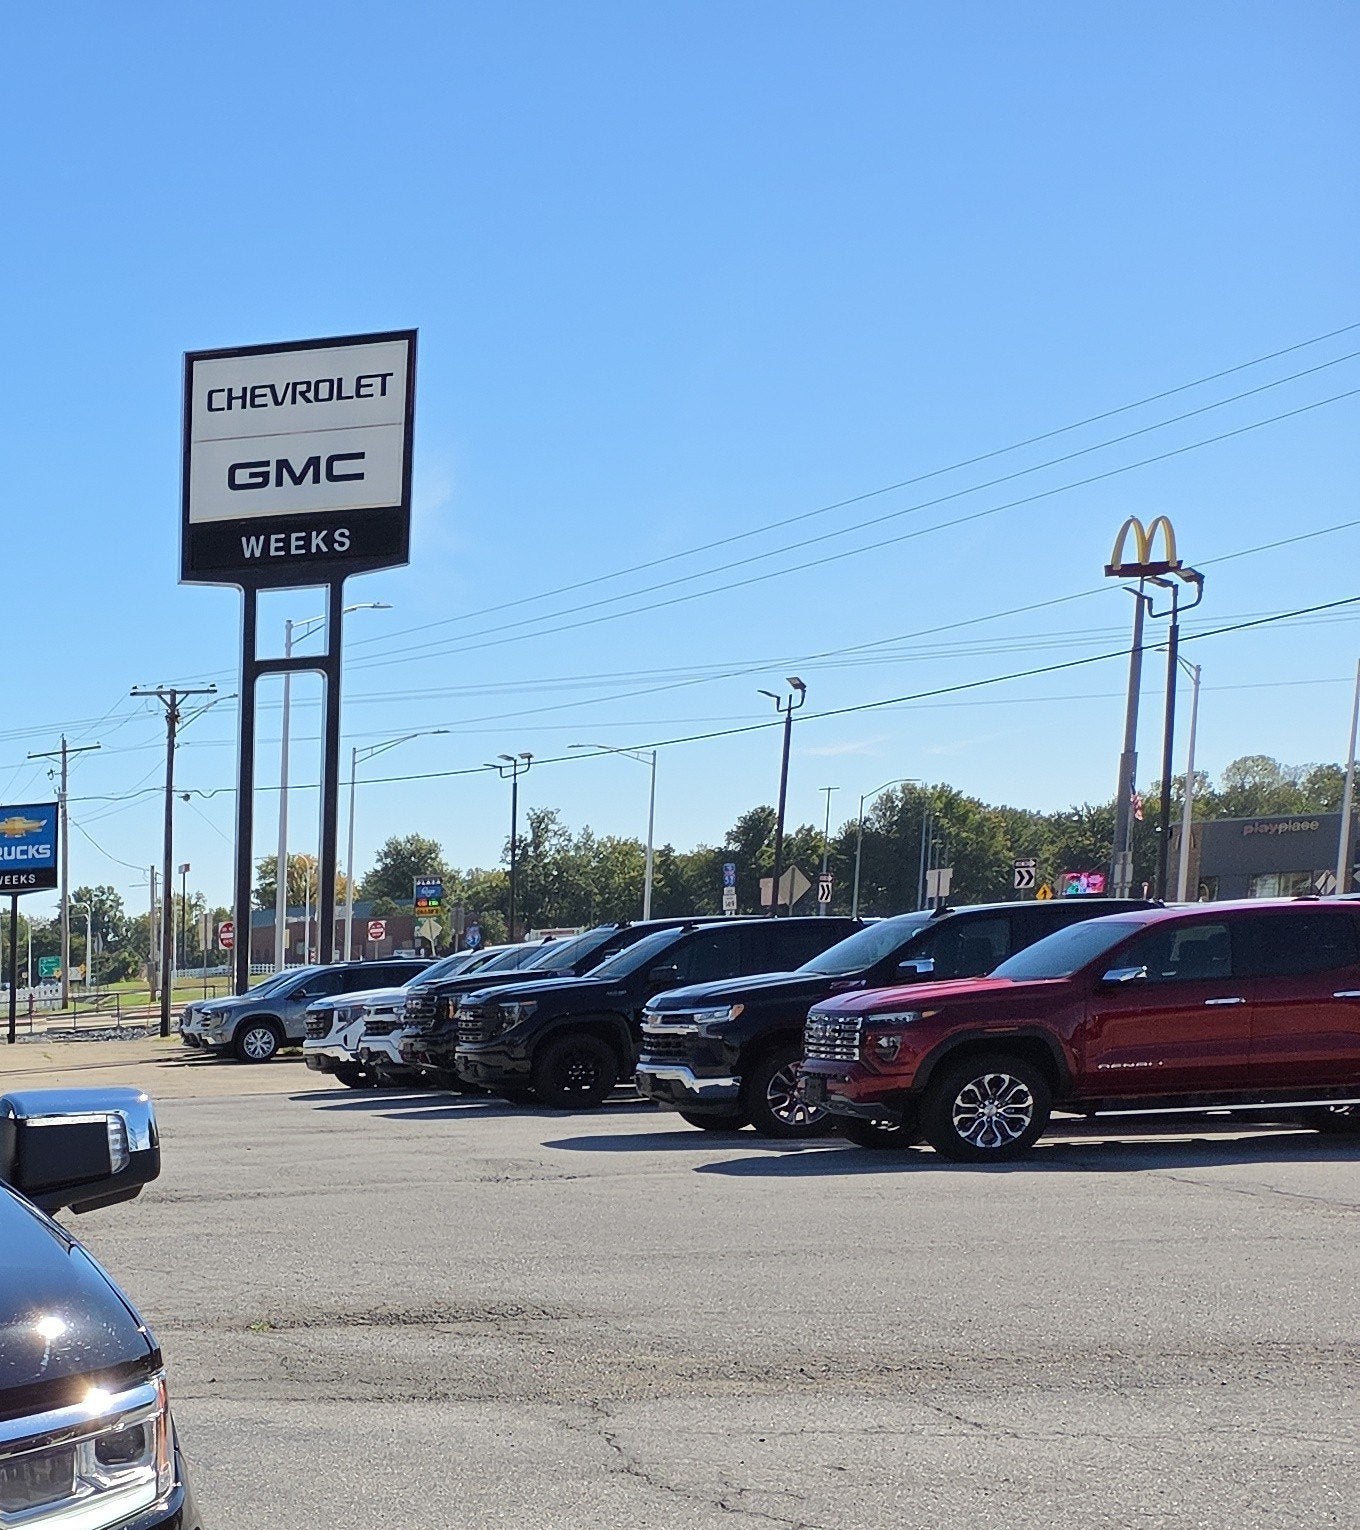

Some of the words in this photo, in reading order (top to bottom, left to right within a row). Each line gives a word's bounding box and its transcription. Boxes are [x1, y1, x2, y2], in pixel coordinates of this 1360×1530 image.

[206, 371, 394, 413] CHEVROLET
[227, 451, 366, 491] GMC
[241, 528, 351, 559] WEEKS
[1243, 820, 1320, 836] playplace
